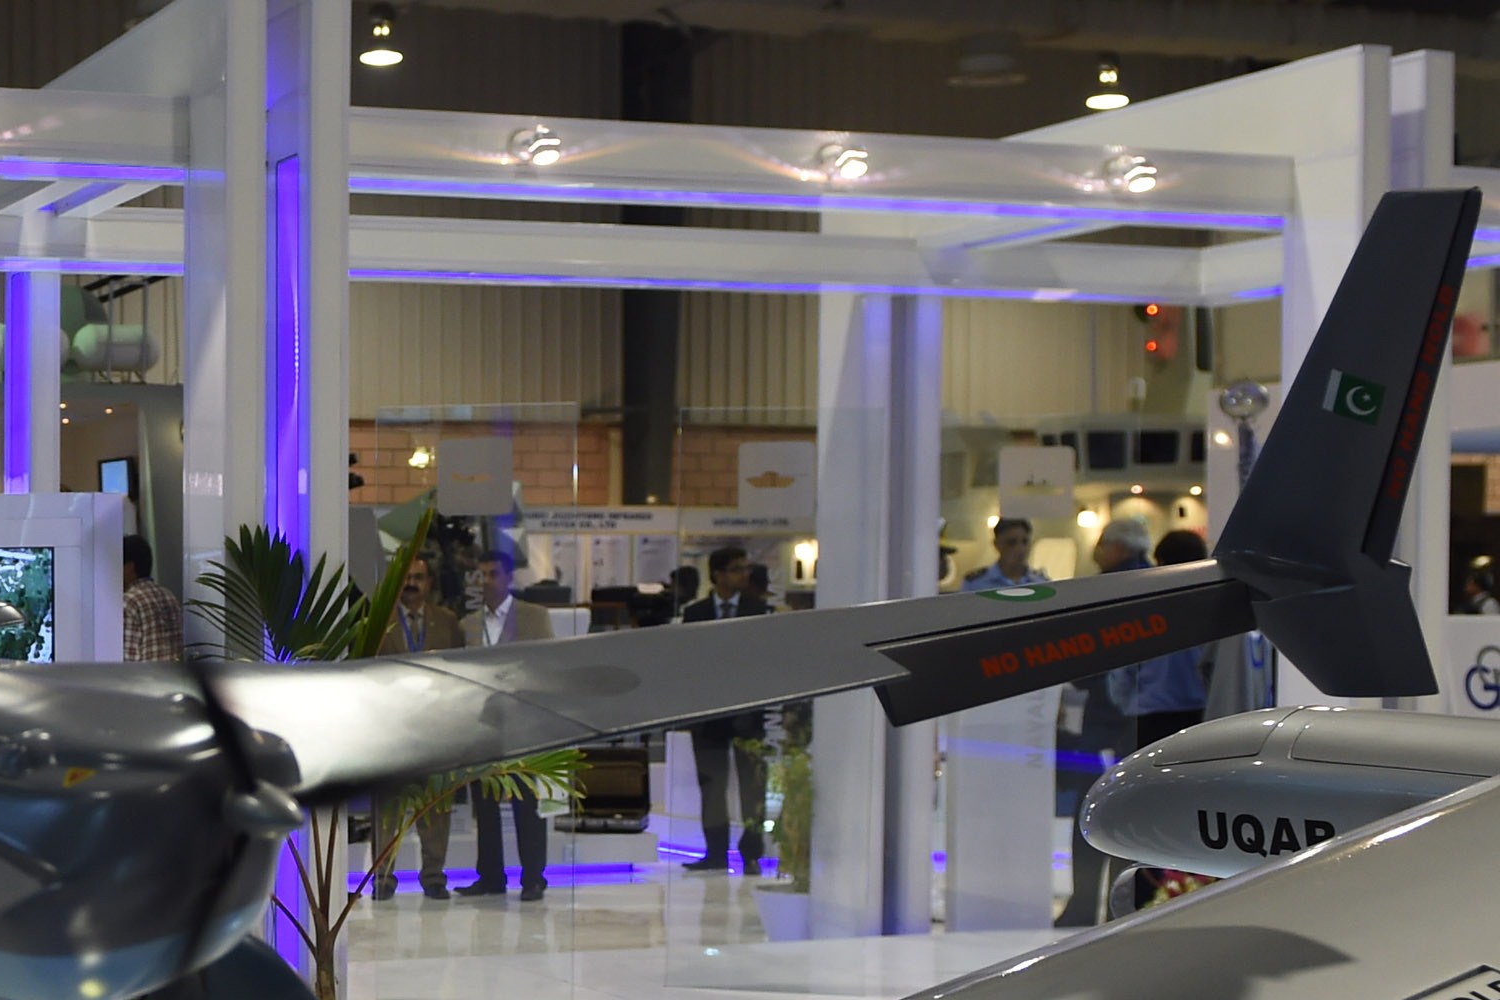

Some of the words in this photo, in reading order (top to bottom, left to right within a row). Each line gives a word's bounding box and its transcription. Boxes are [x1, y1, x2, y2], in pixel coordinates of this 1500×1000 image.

[981, 652, 1020, 678] NO
[1024, 632, 1096, 669] HAND
[1099, 613, 1168, 648] HOLD
